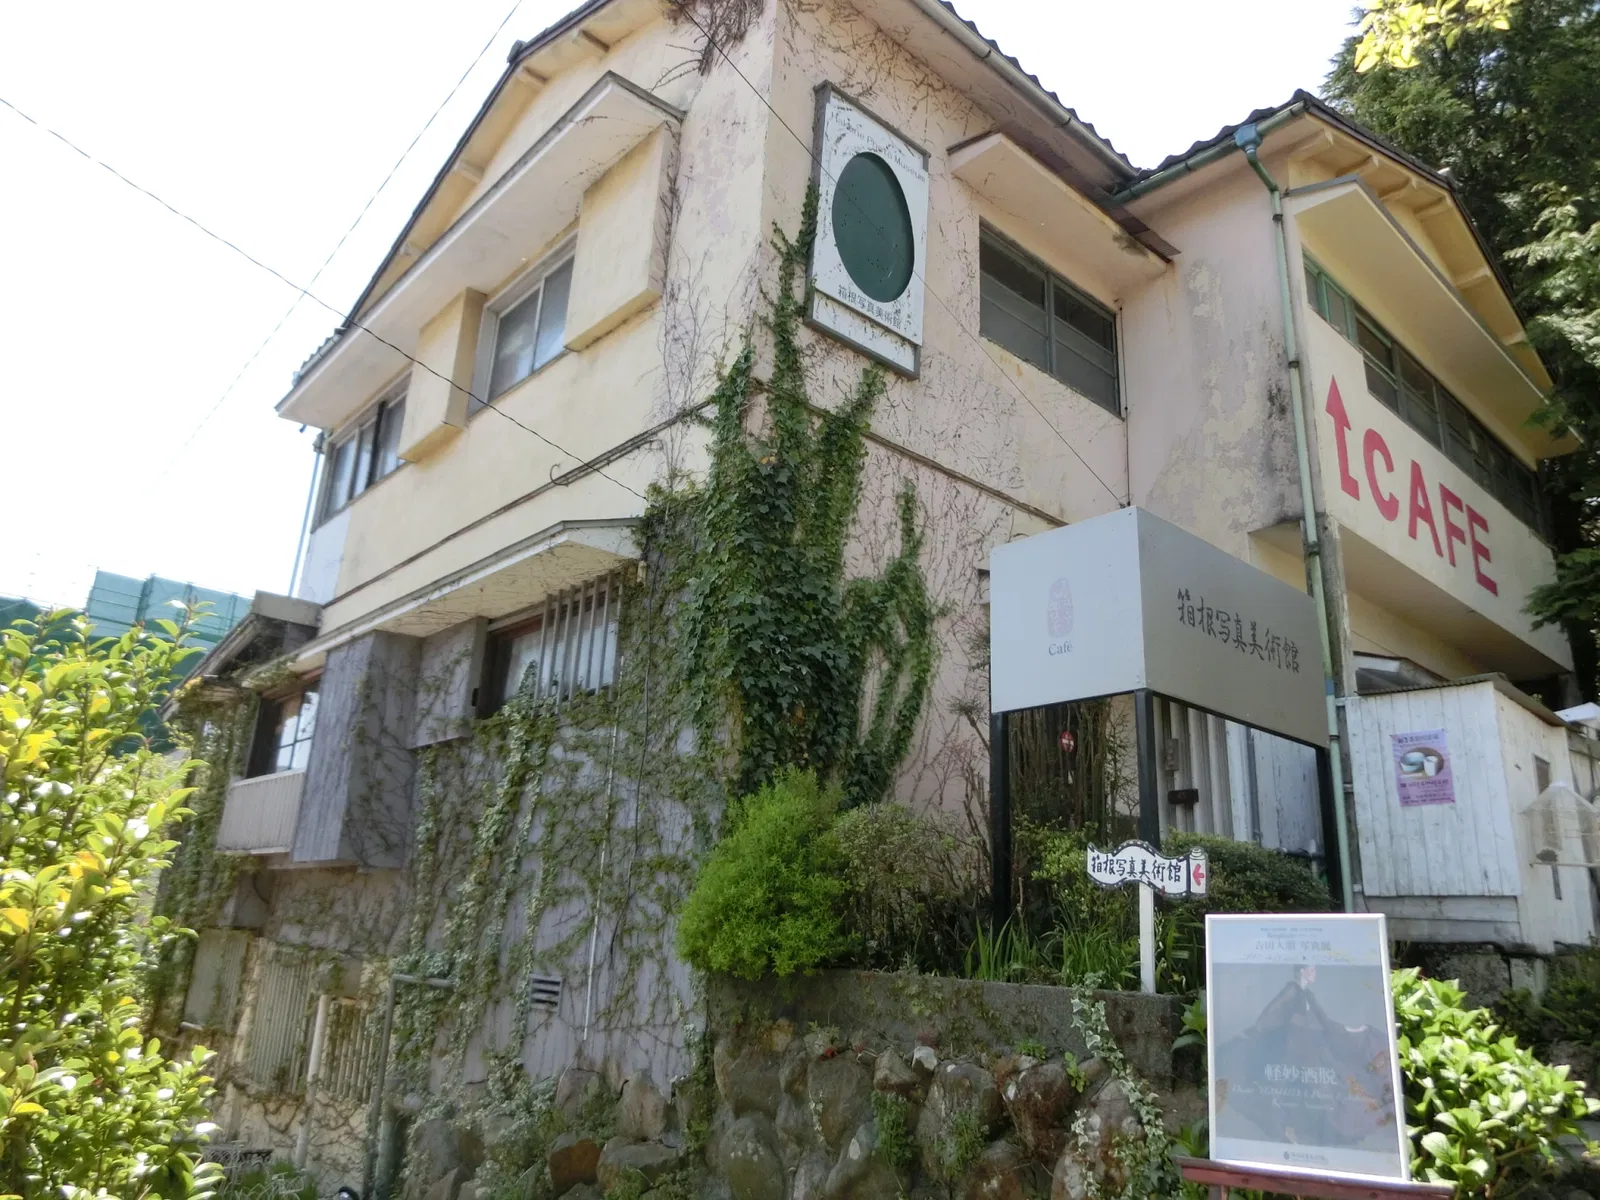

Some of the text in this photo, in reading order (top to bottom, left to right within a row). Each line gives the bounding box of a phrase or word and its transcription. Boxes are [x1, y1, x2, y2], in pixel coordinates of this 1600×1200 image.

[894, 155, 926, 183] Museum
[838, 285, 901, 330] 箱根写真美術館
[1362, 428, 1498, 597] CAFE
[1048, 640, 1073, 656] Café
[1177, 587, 1300, 674] 箱根写真美術館
[1091, 854, 1182, 883] 箱根写真美術館
